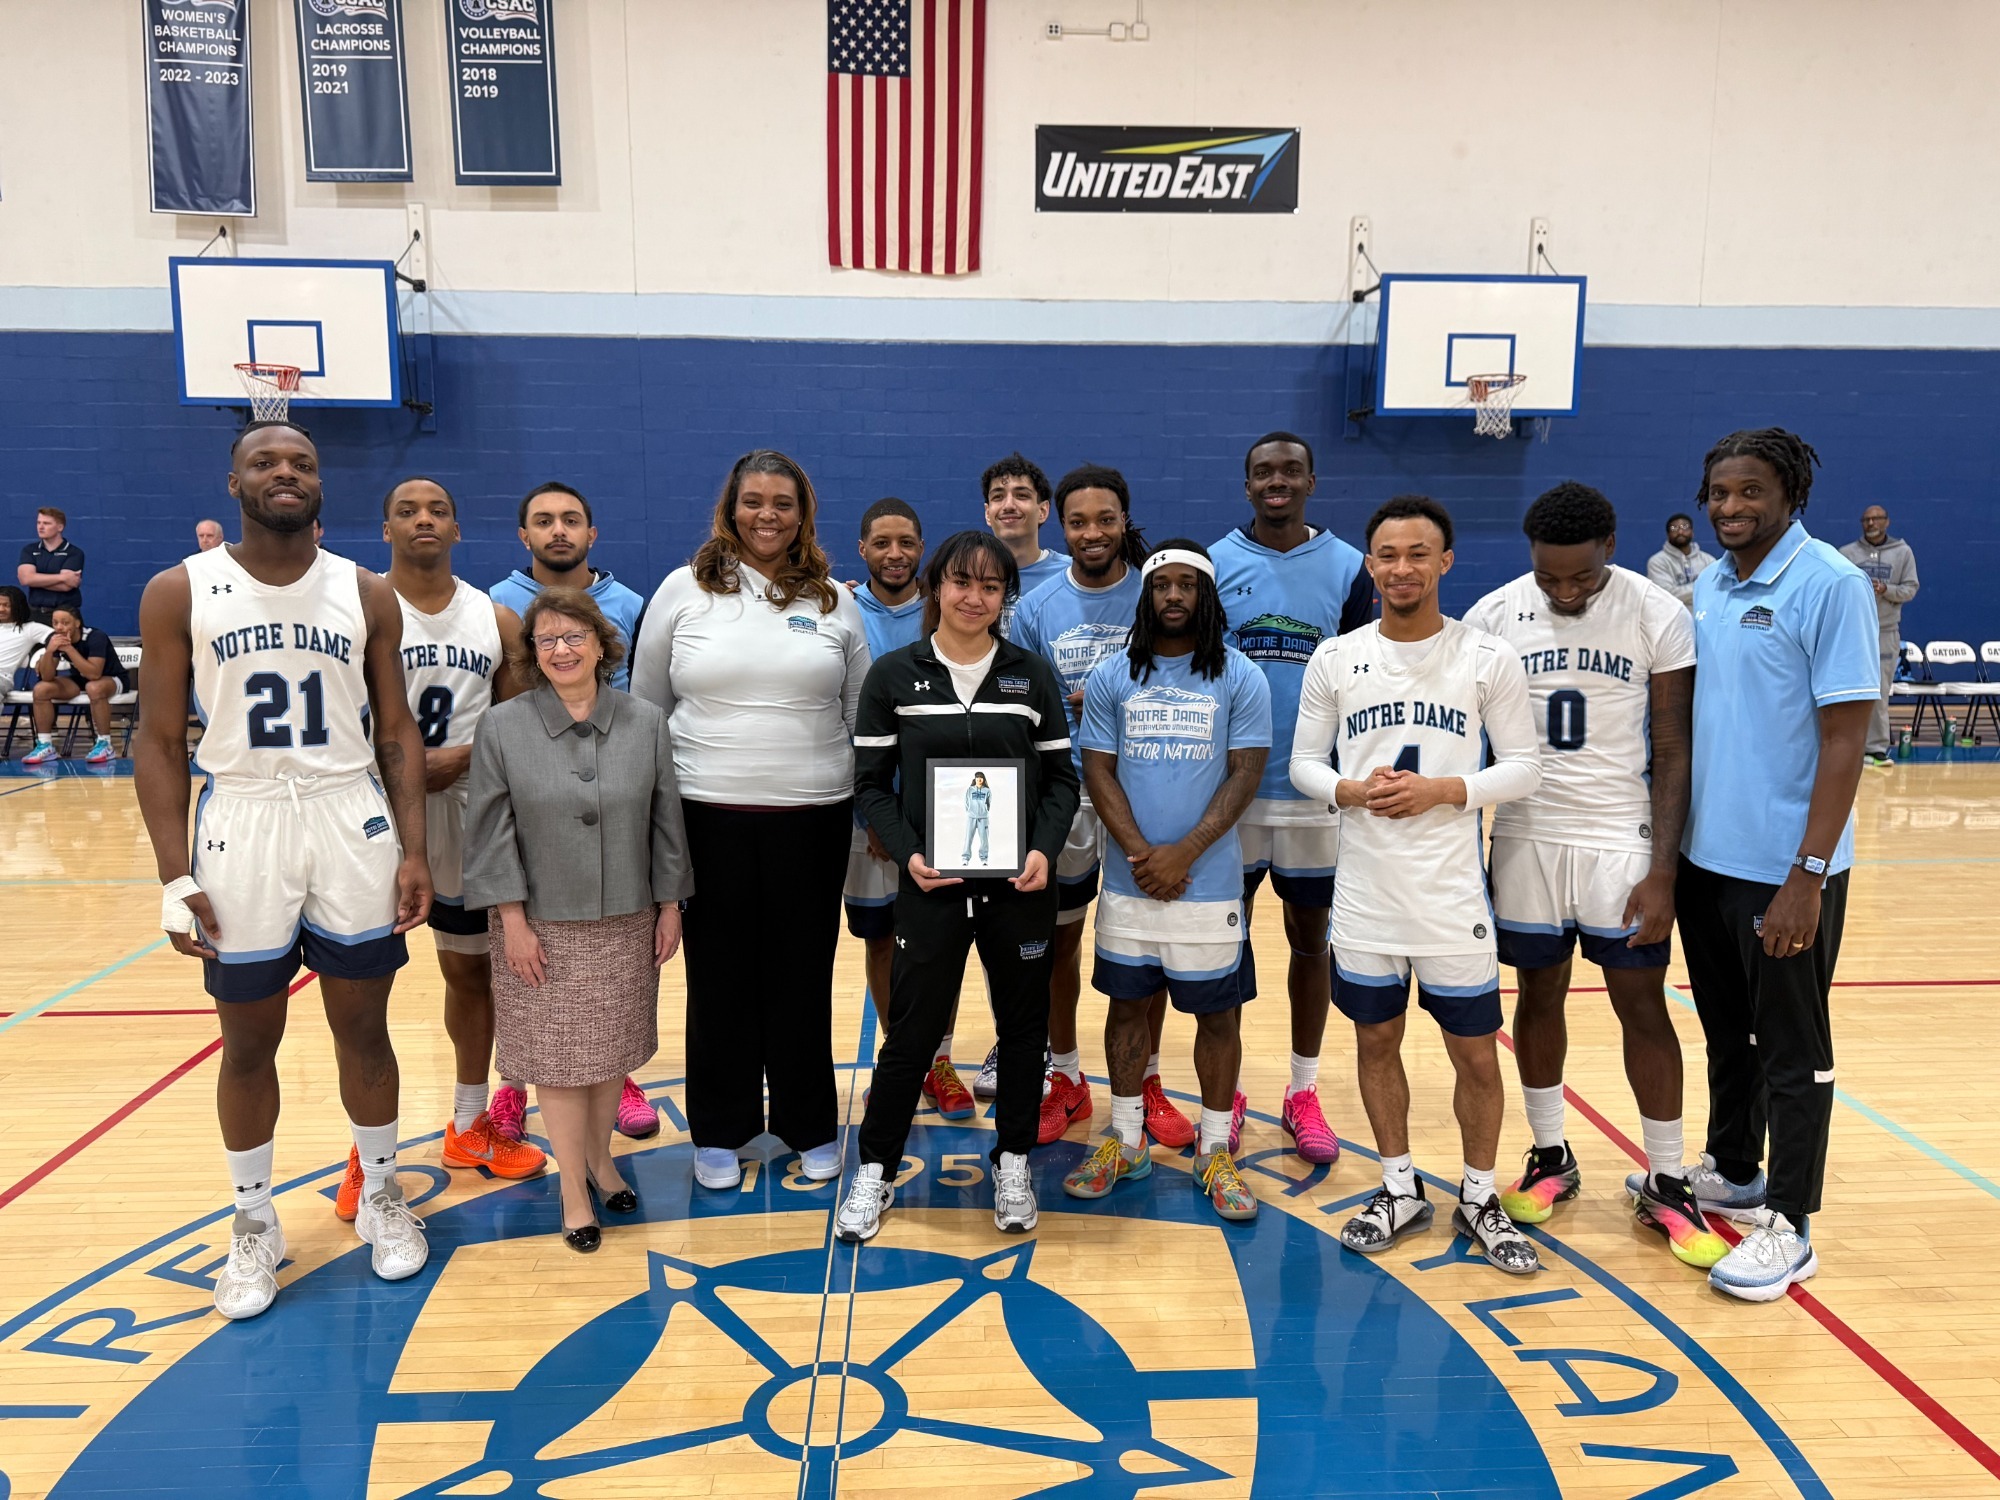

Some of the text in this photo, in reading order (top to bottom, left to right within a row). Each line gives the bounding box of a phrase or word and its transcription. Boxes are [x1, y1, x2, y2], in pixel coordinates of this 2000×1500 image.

[161, 9, 226, 24] WOMEN'S
[154, 25, 241, 41] BASKETBALL
[316, 23, 384, 35] LACROSSE
[459, 27, 541, 39] VOLLEYBALL
[158, 41, 237, 56] CHAMPIONS
[310, 39, 391, 51] CHAMPIONS
[460, 43, 541, 56] CHAMPIONS
[160, 68, 192, 82] 2022
[204, 71, 239, 85] 2023
[312, 64, 347, 77] 2019
[462, 68, 497, 81] 2018
[313, 81, 349, 94] 2021
[463, 85, 499, 98] 2019
[211, 622, 352, 667] NOTRE DAME
[1241, 636, 1316, 653] NOTRE DAME
[1932, 647, 1967, 656] GATORS
[1059, 645, 1096, 660] NOTRE
[1248, 649, 1280, 657] MARYLAND
[1281, 650, 1313, 660] UNIVERSIT
[400, 644, 492, 680] TRE DAME
[1521, 648, 1633, 682] TRE DAME
[244, 669, 329, 750] 21
[417, 685, 454, 747] 8
[1129, 708, 1209, 725] NOTRE DAME
[1346, 701, 1467, 740] NOTRE DAME
[1546, 688, 1587, 751] 0
[1172, 724, 1208, 734] UNIVERSITY
